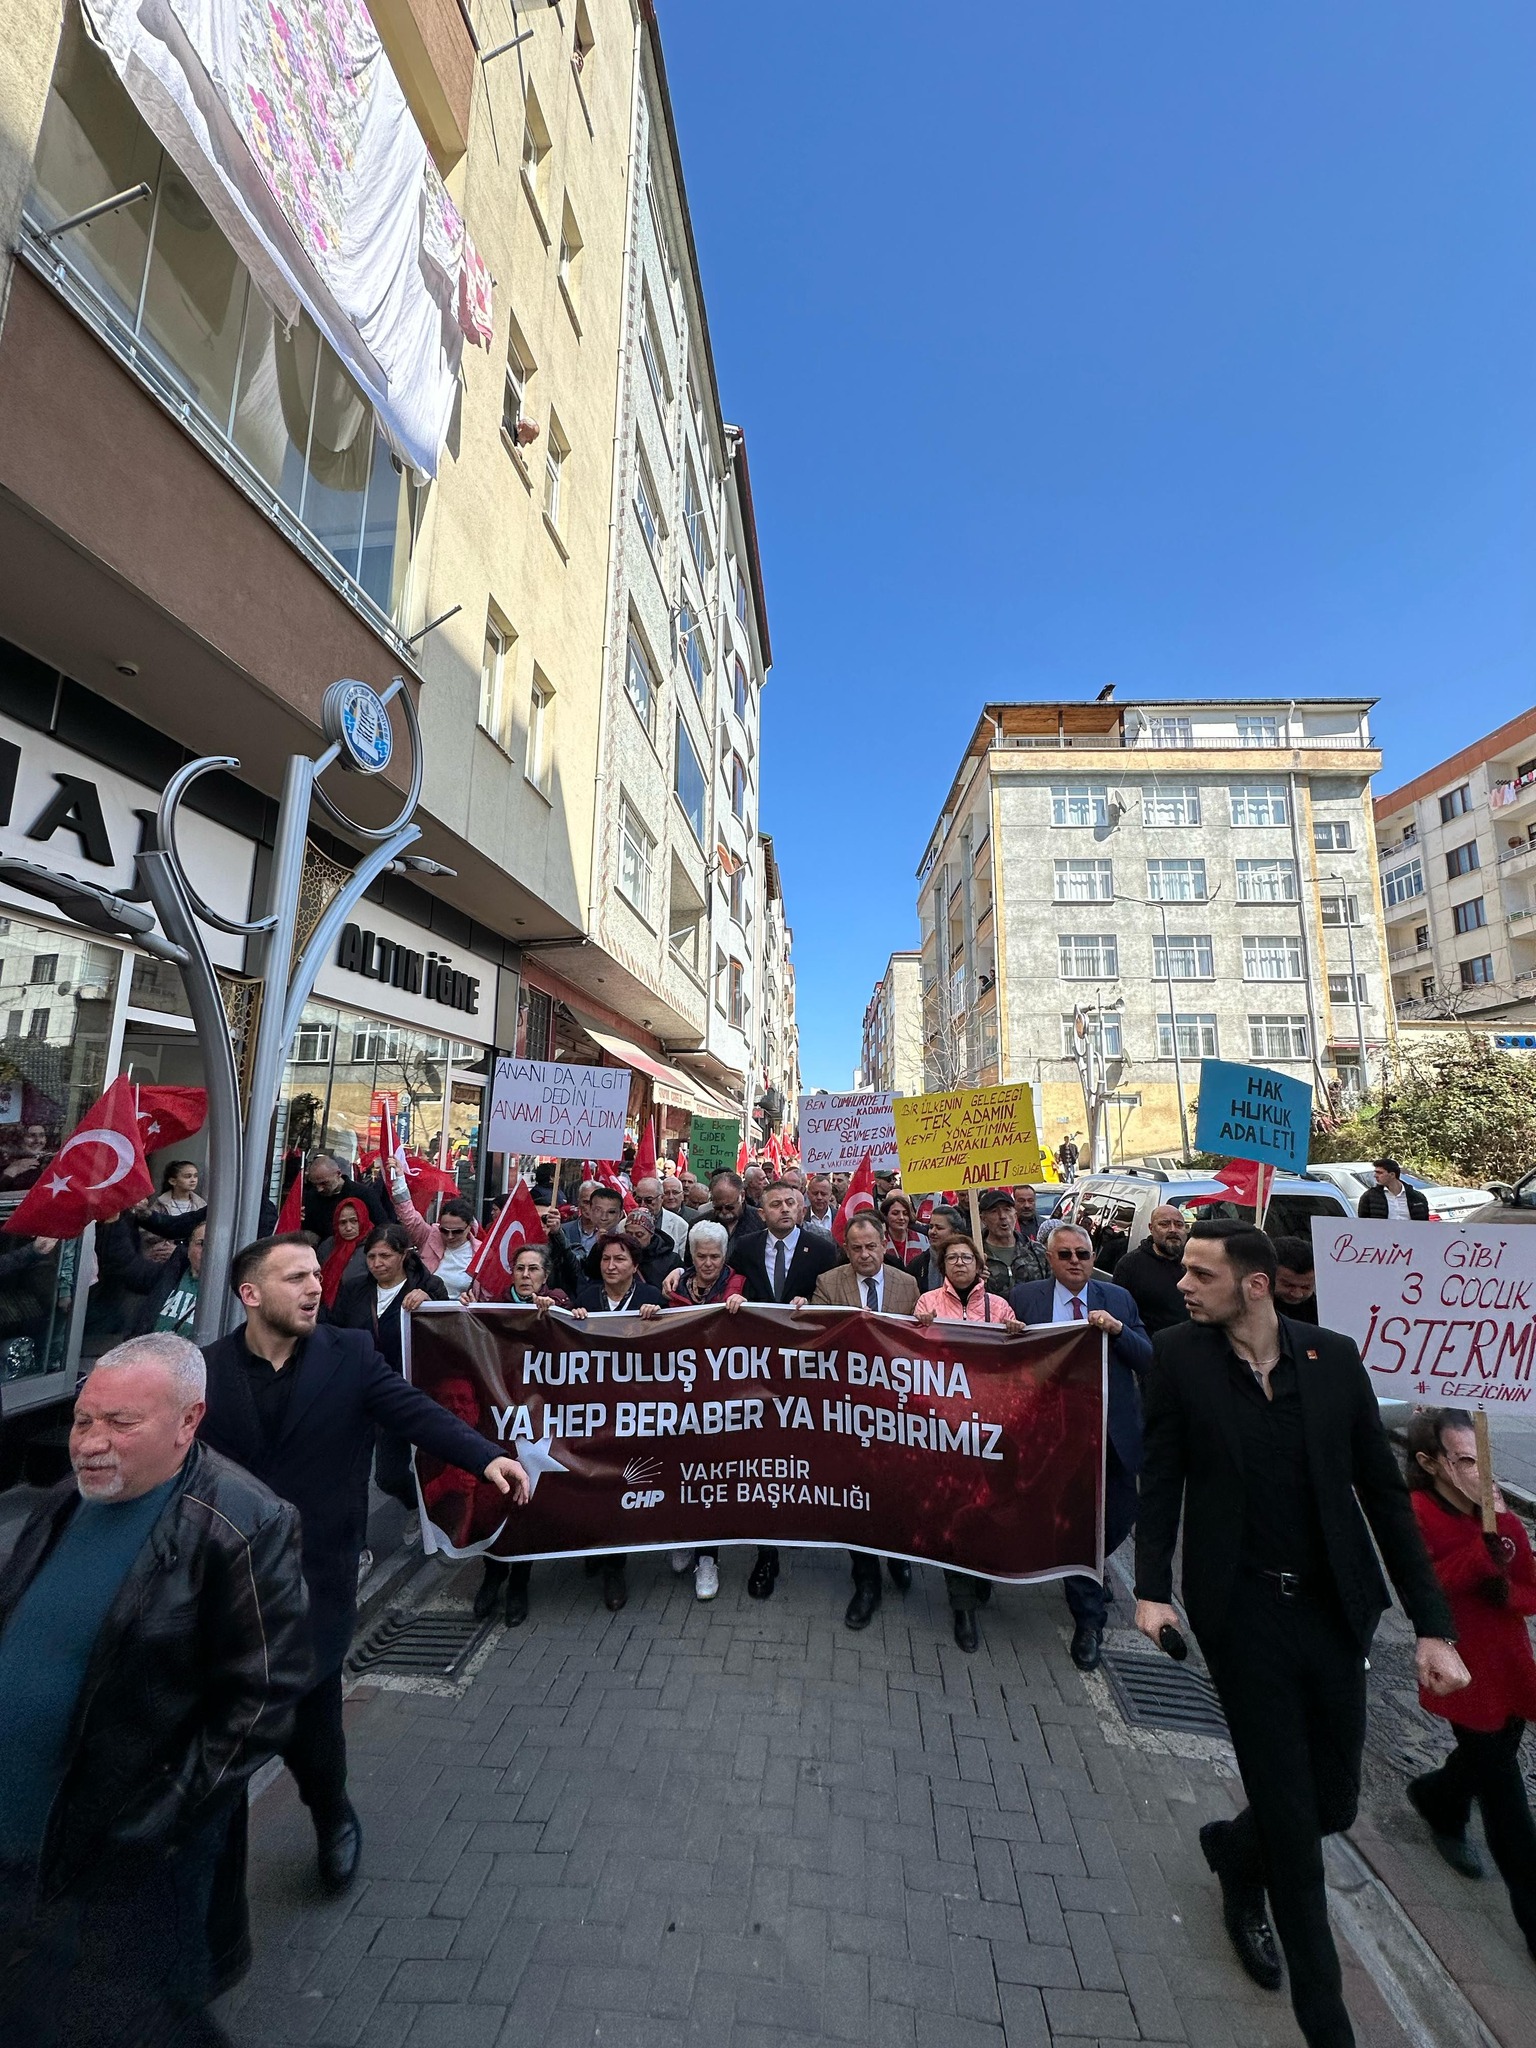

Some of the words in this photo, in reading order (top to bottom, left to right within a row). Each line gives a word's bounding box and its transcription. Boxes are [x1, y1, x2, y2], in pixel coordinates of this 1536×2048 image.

[337, 922, 424, 994] ALTIN
[424, 951, 480, 1014] İĞNE
[553, 1067, 575, 1086] DA
[1247, 1076, 1283, 1102] HAK
[491, 1099, 543, 1123] ANAMI
[550, 1105, 571, 1126] DA
[576, 1108, 623, 1129] ALDIM
[805, 1098, 826, 1111] BEN
[1231, 1099, 1292, 1129] HUKUK
[531, 1126, 592, 1147] GELDİM
[904, 1130, 938, 1147] KEYFİ
[941, 1131, 1032, 1154] BIRAKILAMAZ
[1219, 1122, 1295, 1159] ADALET!
[962, 1158, 1012, 1185] ADALET
[1329, 1233, 1414, 1266] BENİM
[1443, 1240, 1508, 1269] GİBİ
[1401, 1272, 1424, 1305] 3
[522, 1348, 698, 1393] KURTULUŞ
[704, 1346, 772, 1382] YOK
[778, 1347, 840, 1382] TEK
[847, 1350, 972, 1404] BAŞINA
[490, 1404, 535, 1441] YA
[542, 1402, 608, 1440] HEP
[614, 1398, 764, 1438] BERABER
[772, 1396, 815, 1431] YA
[823, 1393, 1004, 1462] HİÇBİRİMİZ
[680, 1454, 811, 1482] VAKFIKEBİR
[621, 1489, 665, 1510] CHP
[680, 1480, 729, 1509] İLÇE
[736, 1482, 871, 1512] BAŞKANLIĞI
